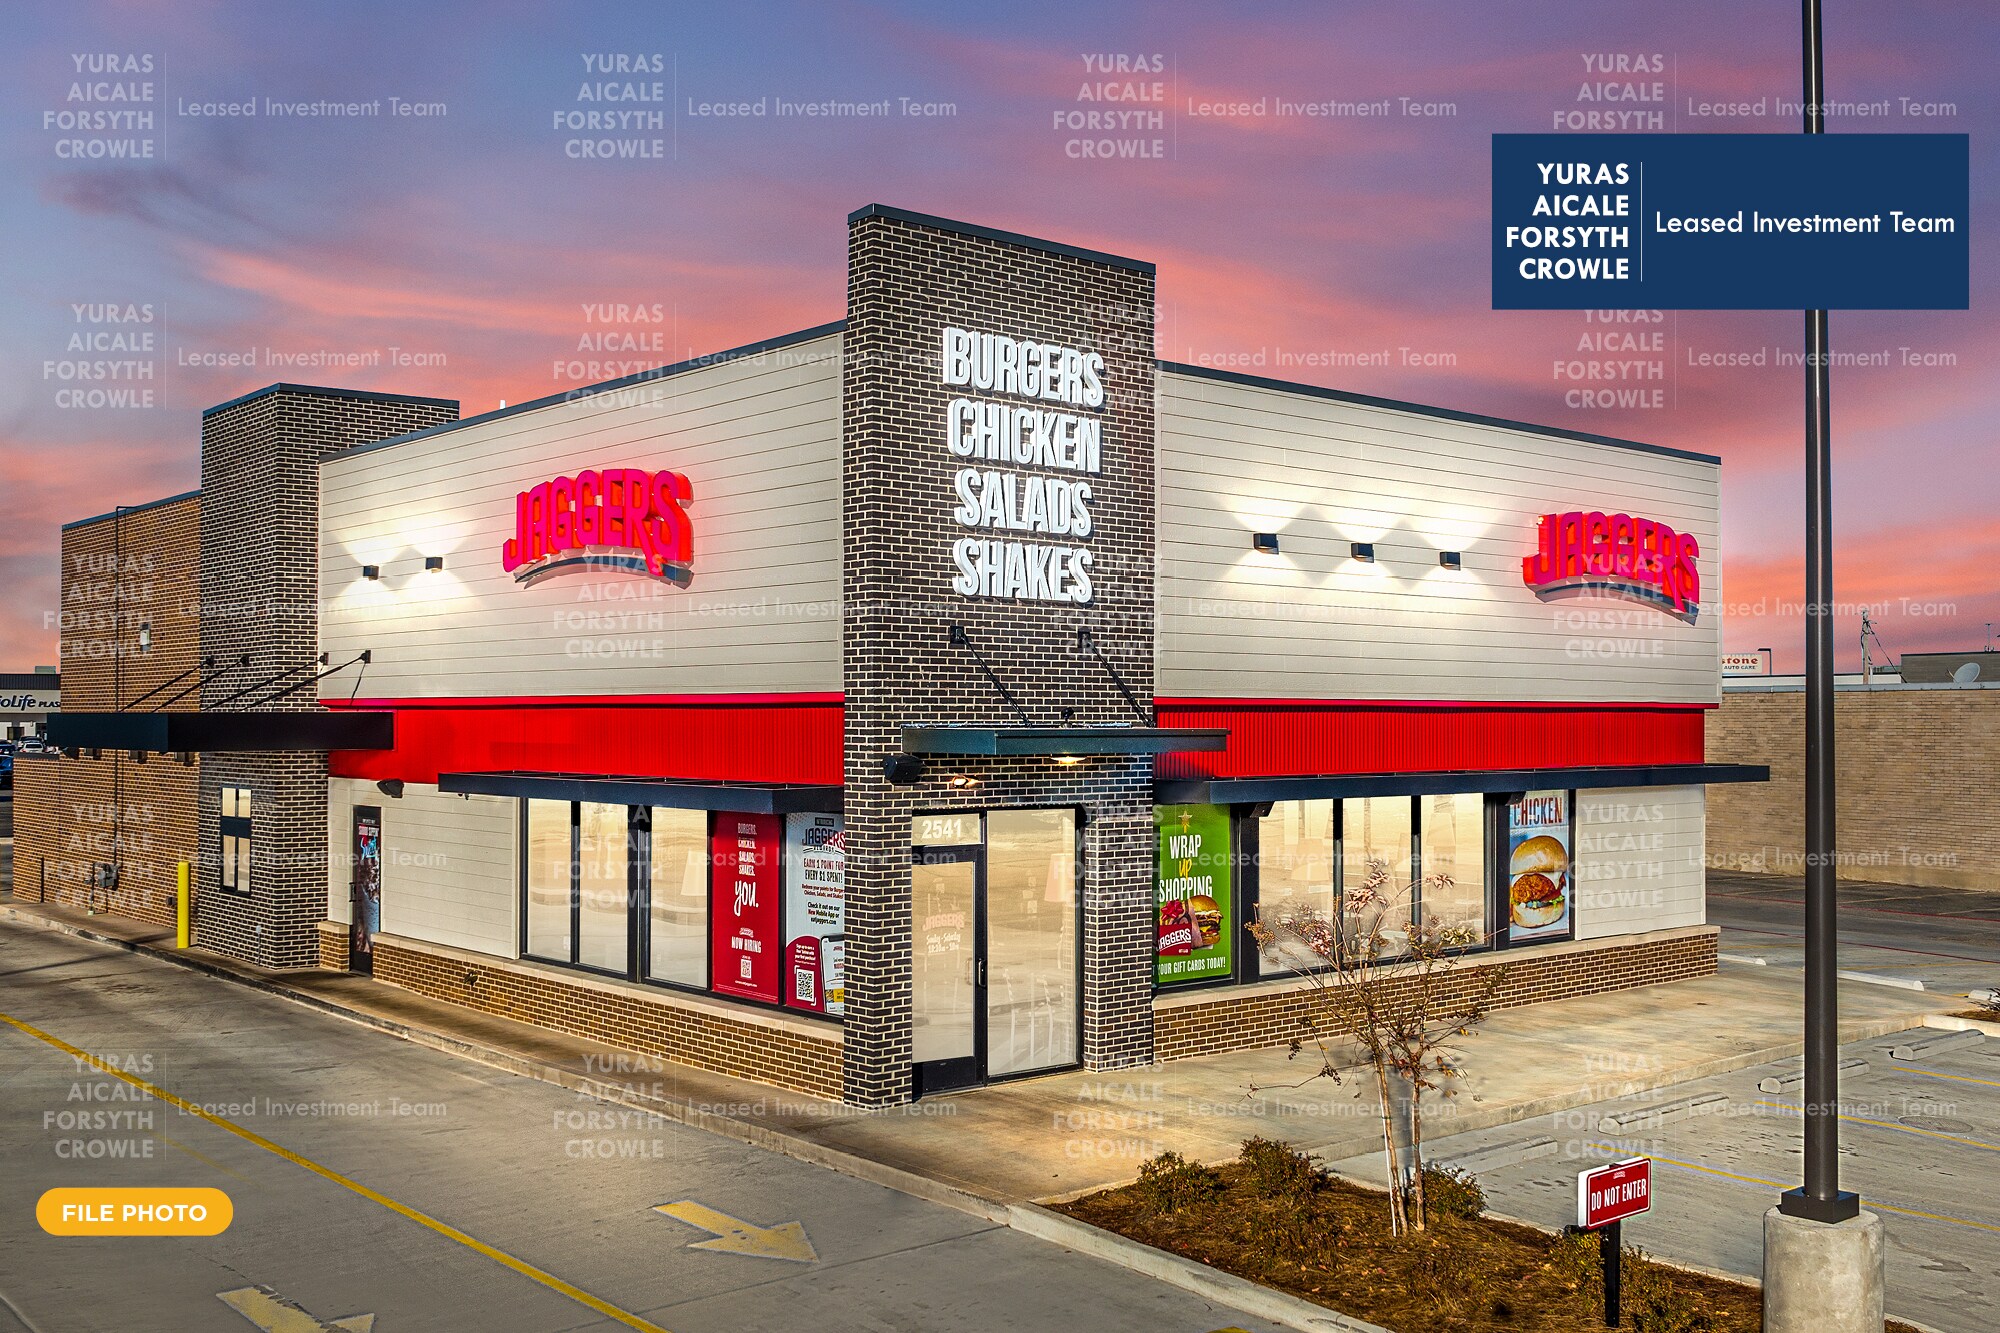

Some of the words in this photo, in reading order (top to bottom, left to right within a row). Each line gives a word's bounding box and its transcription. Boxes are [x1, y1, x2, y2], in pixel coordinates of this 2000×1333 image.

[942, 326, 1104, 408] BURGERS
[947, 398, 1101, 474] CHICKEN
[954, 468, 1092, 537] SALADS
[503, 468, 694, 576] JAGGERS
[952, 537, 1093, 603] SHAKES
[1522, 511, 1700, 613] JAGGERS
[1514, 797, 1563, 826] CHICKEN
[802, 828, 846, 850] JAGGERS
[922, 819, 962, 839] 2541
[1170, 834, 1202, 859] WRAP
[804, 858, 815, 868] EARN
[817, 860, 820, 869] 1
[821, 860, 834, 870] POINT
[836, 862, 844, 871] FOR
[805, 870, 817, 880] EVERY
[819, 871, 825, 881] $1
[827, 872, 843, 883] SPENT!
[1159, 875, 1212, 902] SHOPPING
[922, 911, 966, 931] JAGGERS
[731, 936, 744, 950] NOW
[744, 938, 762, 953] HIRING
[1174, 961, 1186, 973] GIFT
[1188, 959, 1205, 972] CARDS
[1207, 957, 1226, 969] TODAY!
[1591, 1192, 1602, 1211] DO
[1604, 1185, 1620, 1207] NOT
[1622, 1179, 1646, 1201] ENTER
